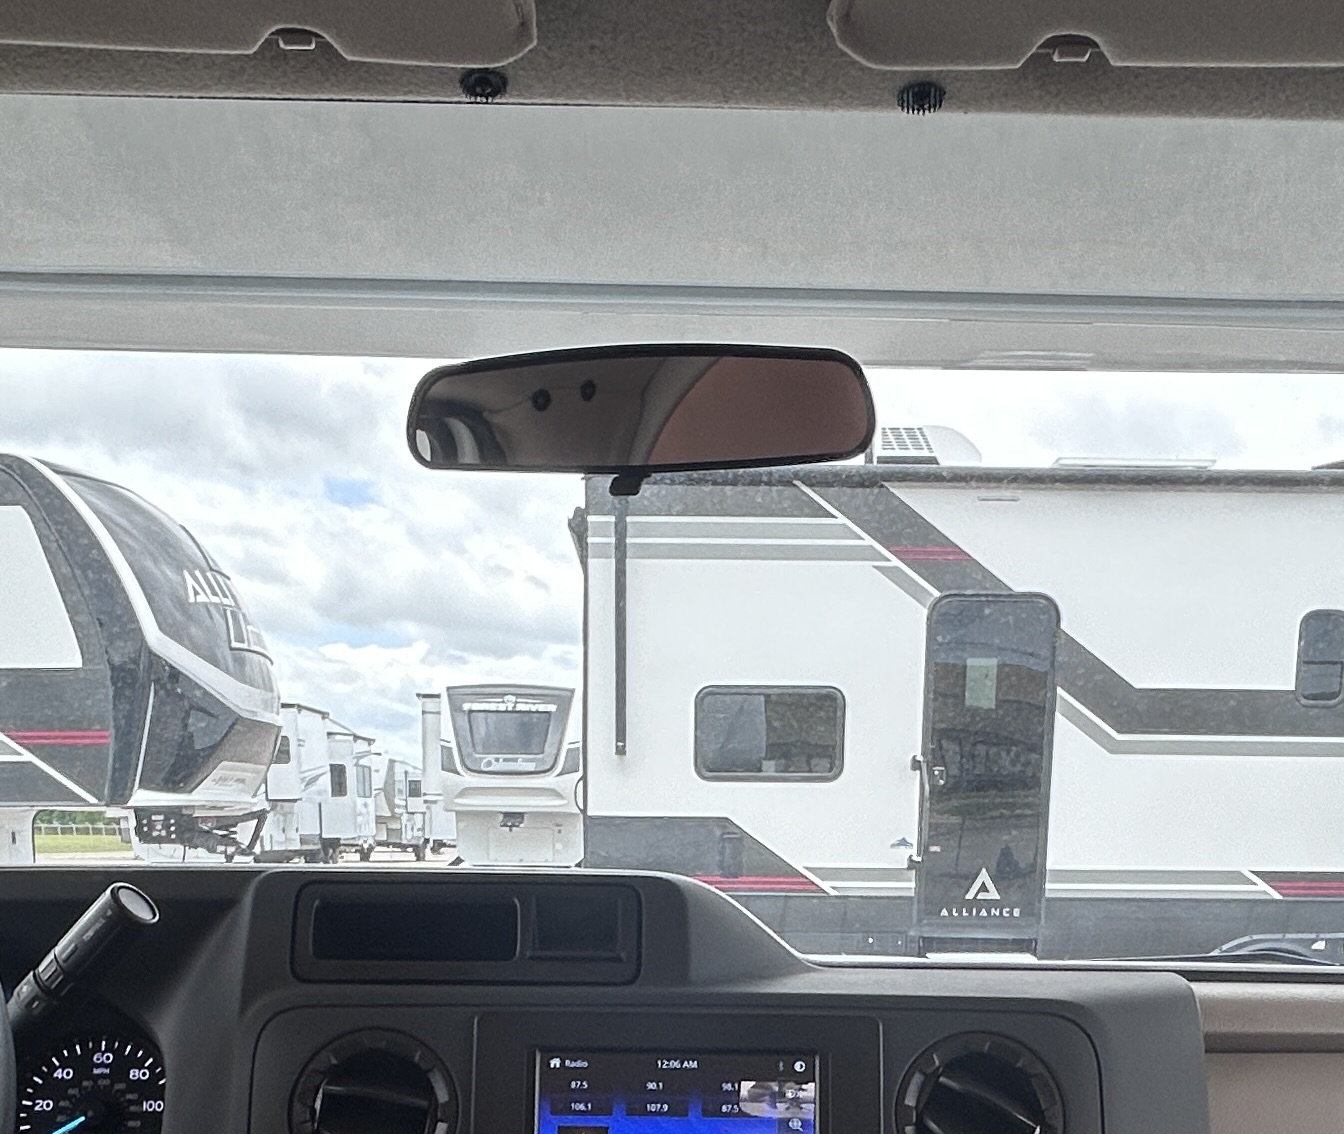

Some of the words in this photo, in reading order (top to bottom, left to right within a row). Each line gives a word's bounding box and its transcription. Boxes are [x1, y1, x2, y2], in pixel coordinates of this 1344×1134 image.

[92, 1052, 114, 1064] 60
[564, 1059, 589, 1069] Radio
[657, 1059, 681, 1069] 12:06
[682, 1060, 698, 1069] AM
[53, 1068, 74, 1080] 40
[129, 1068, 150, 1080] 80
[34, 1099, 54, 1111] 20
[142, 1100, 165, 1112] 100
